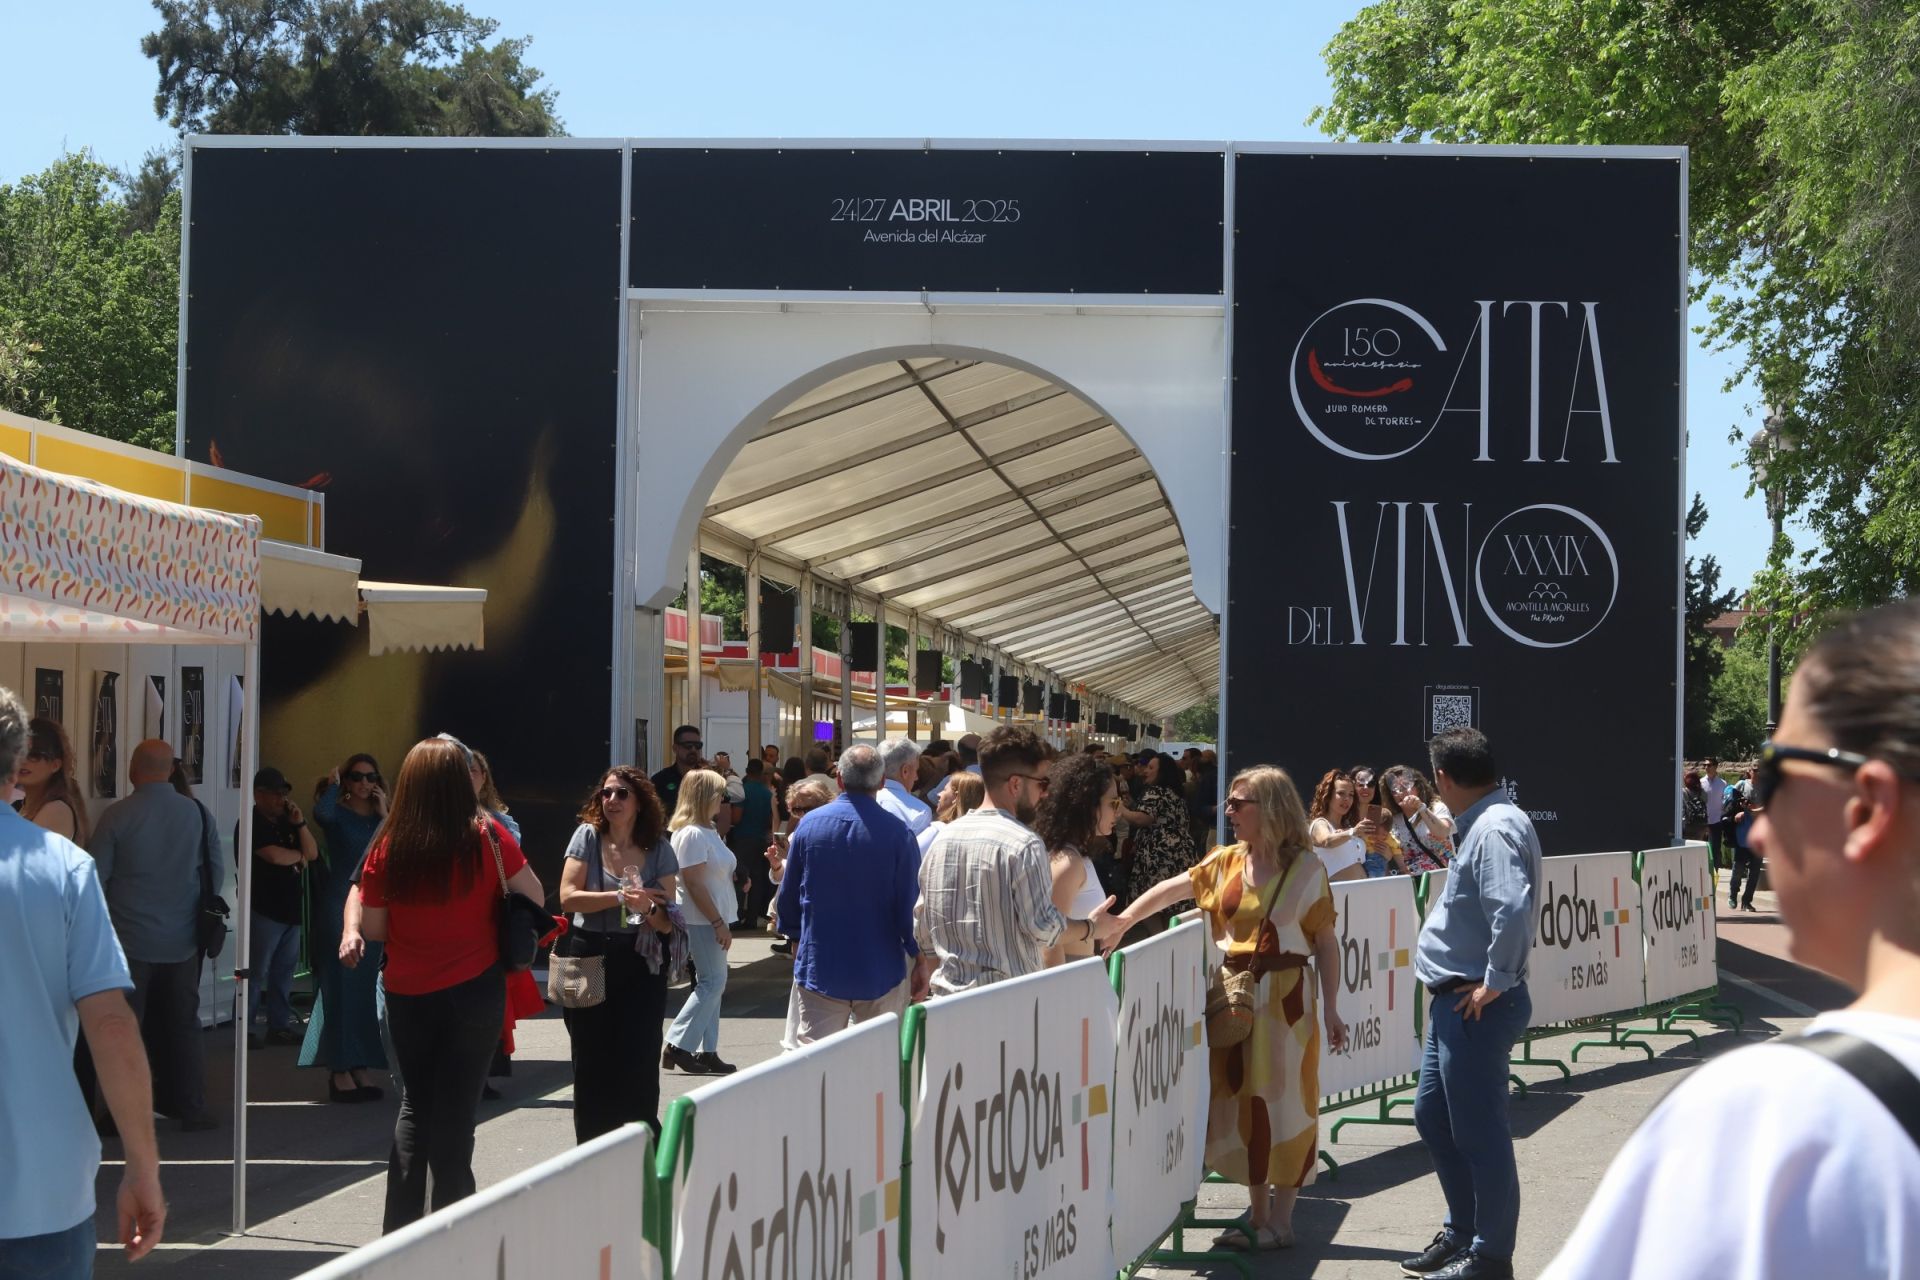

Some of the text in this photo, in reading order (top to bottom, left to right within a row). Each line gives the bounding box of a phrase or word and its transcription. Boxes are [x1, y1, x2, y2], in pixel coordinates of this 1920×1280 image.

[888, 199, 960, 222] ABRIL
[961, 199, 1021, 223] 2025
[863, 229, 987, 244] Avenida del Alcázar
[1344, 327, 1401, 357] 150
[1323, 360, 1422, 369] aniversario
[1289, 297, 1622, 463] CATA
[1325, 404, 1388, 414] JULIO ROMERO
[1365, 417, 1376, 425] DE
[1503, 534, 1590, 576] XXXIX
[1288, 501, 1619, 649] DEL VINO
[1505, 601, 1590, 612] MONTILLA MORILES
[1571, 966, 1584, 990] ES
[1024, 1224, 1039, 1280] ES
